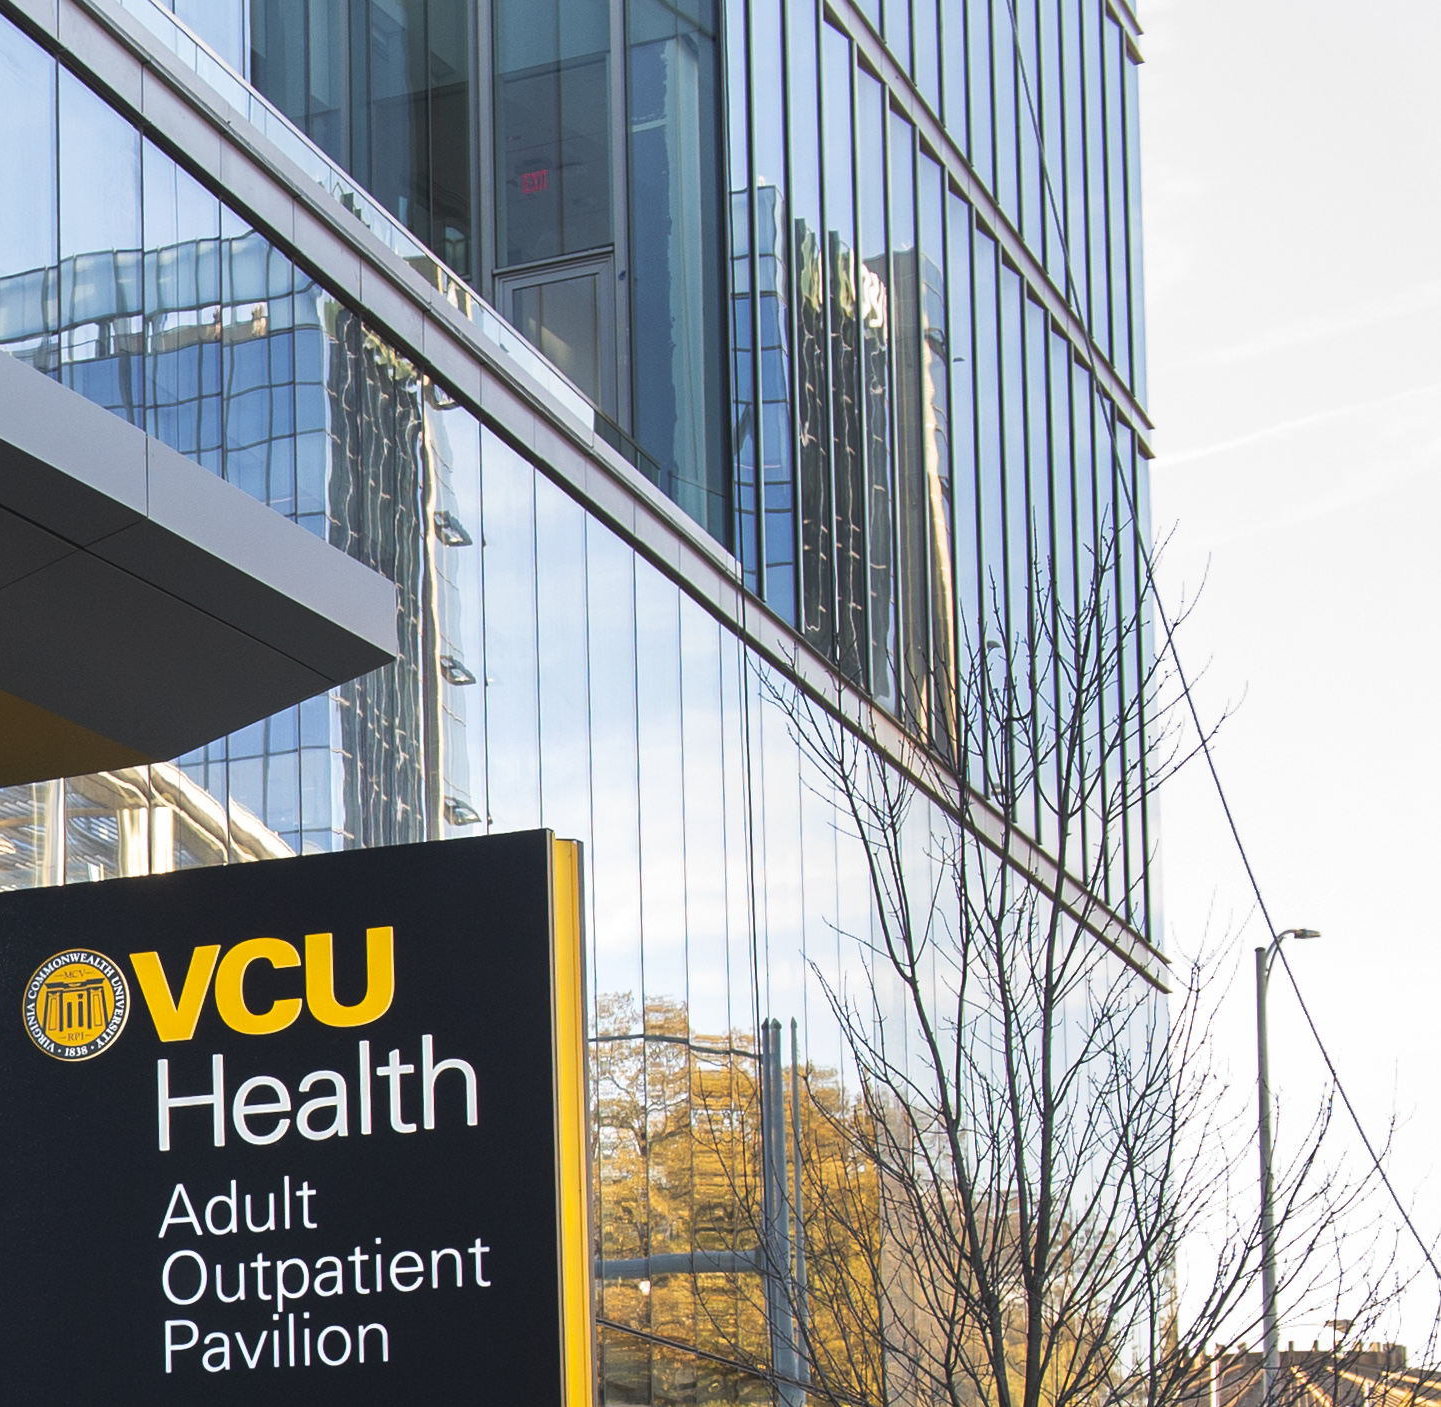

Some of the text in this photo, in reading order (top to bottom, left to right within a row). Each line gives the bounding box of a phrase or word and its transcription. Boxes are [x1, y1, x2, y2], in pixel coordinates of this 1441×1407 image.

[26, 952, 125, 1053] VIRGINIA COMMONWEALTH UNIVERSITY
[128, 925, 395, 1043] VCU
[64, 1045, 89, 1057] 1838
[67, 1031, 84, 1042] RPI
[156, 1033, 479, 1152] Health
[157, 1175, 318, 1239] Adult
[160, 1237, 492, 1313] Outpatient
[164, 1311, 390, 1374] Pavilion
